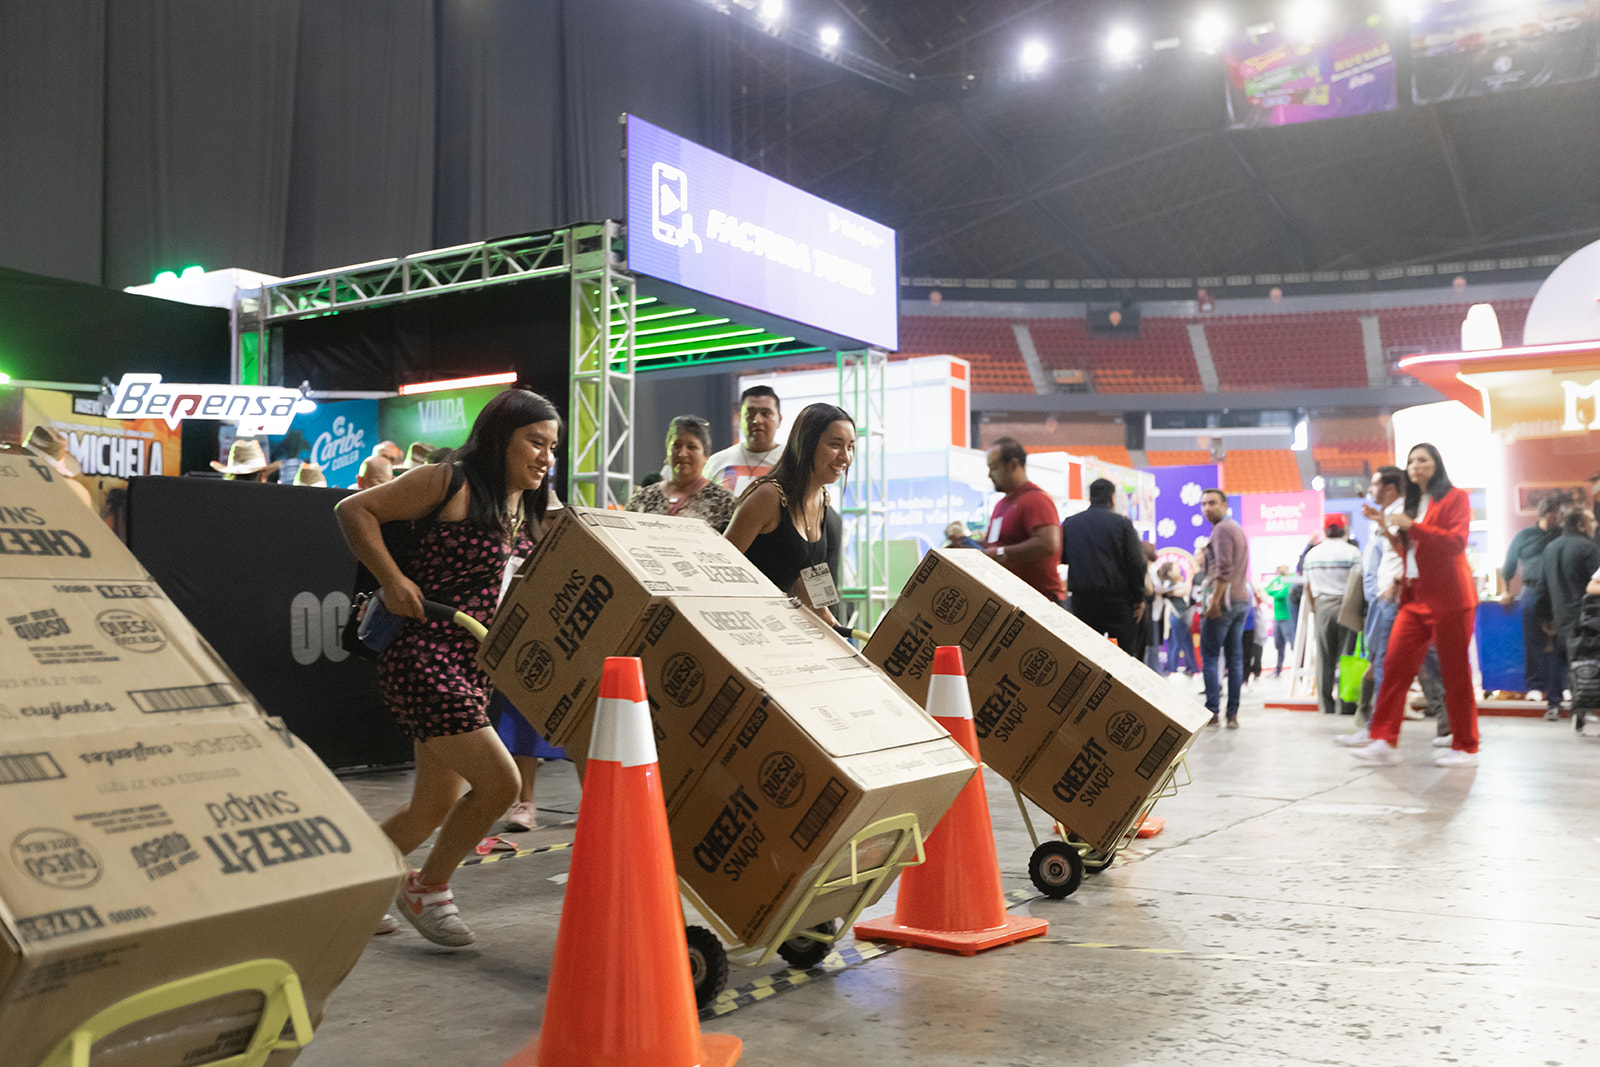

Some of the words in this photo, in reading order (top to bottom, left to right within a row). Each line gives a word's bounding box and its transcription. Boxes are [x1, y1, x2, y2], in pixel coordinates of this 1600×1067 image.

[554, 574, 614, 660] CHEEZ-IT
[935, 588, 960, 619] QUESO
[883, 613, 933, 677] CHEEZ-IT
[1023, 649, 1050, 682] QUESO
[523, 650, 552, 689] QUESO
[664, 655, 696, 699] QUESO
[1109, 712, 1137, 746] QUESO
[761, 754, 796, 800] QUESO
[1052, 736, 1108, 804] CHEEZ-IT
[692, 784, 759, 874] CHEEZ-IT
